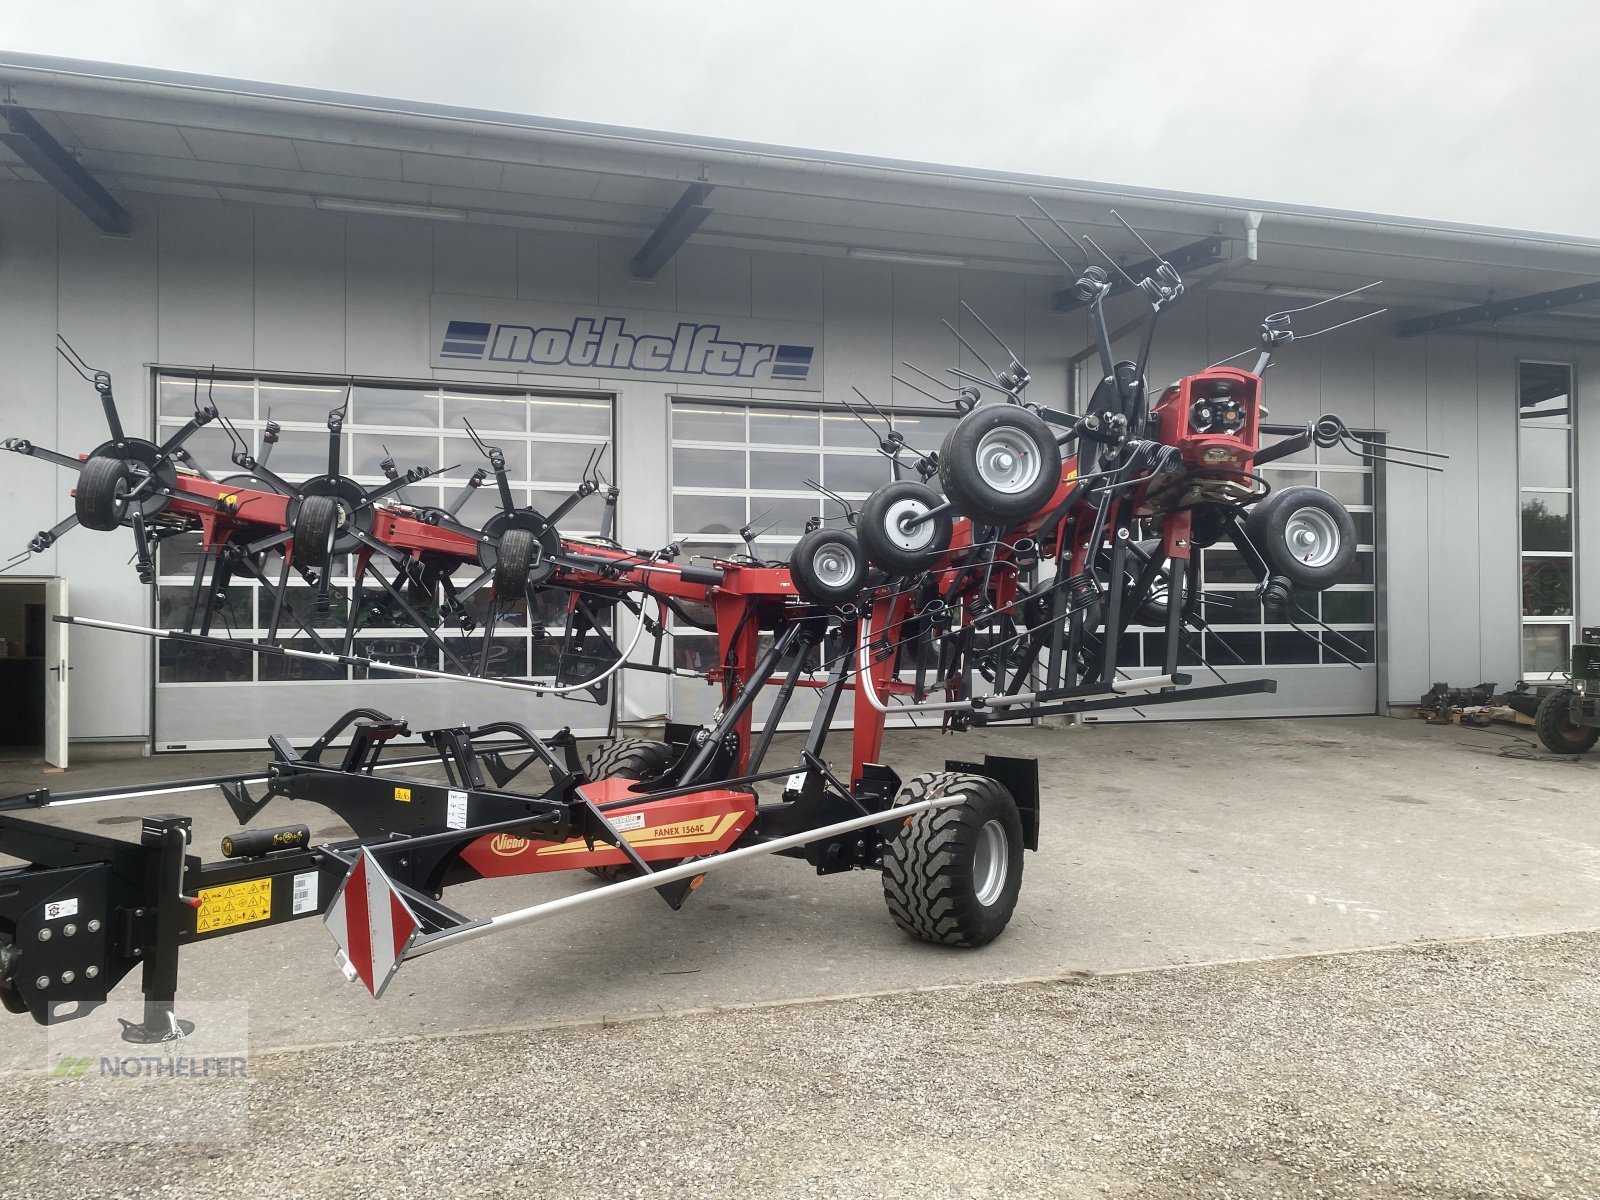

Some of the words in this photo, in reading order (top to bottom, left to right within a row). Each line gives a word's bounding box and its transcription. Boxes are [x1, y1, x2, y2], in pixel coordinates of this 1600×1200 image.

[489, 316, 775, 378] nothelfer
[654, 826, 680, 838] FANEX
[682, 824, 705, 835] 1564C
[496, 833, 525, 850] Vicon
